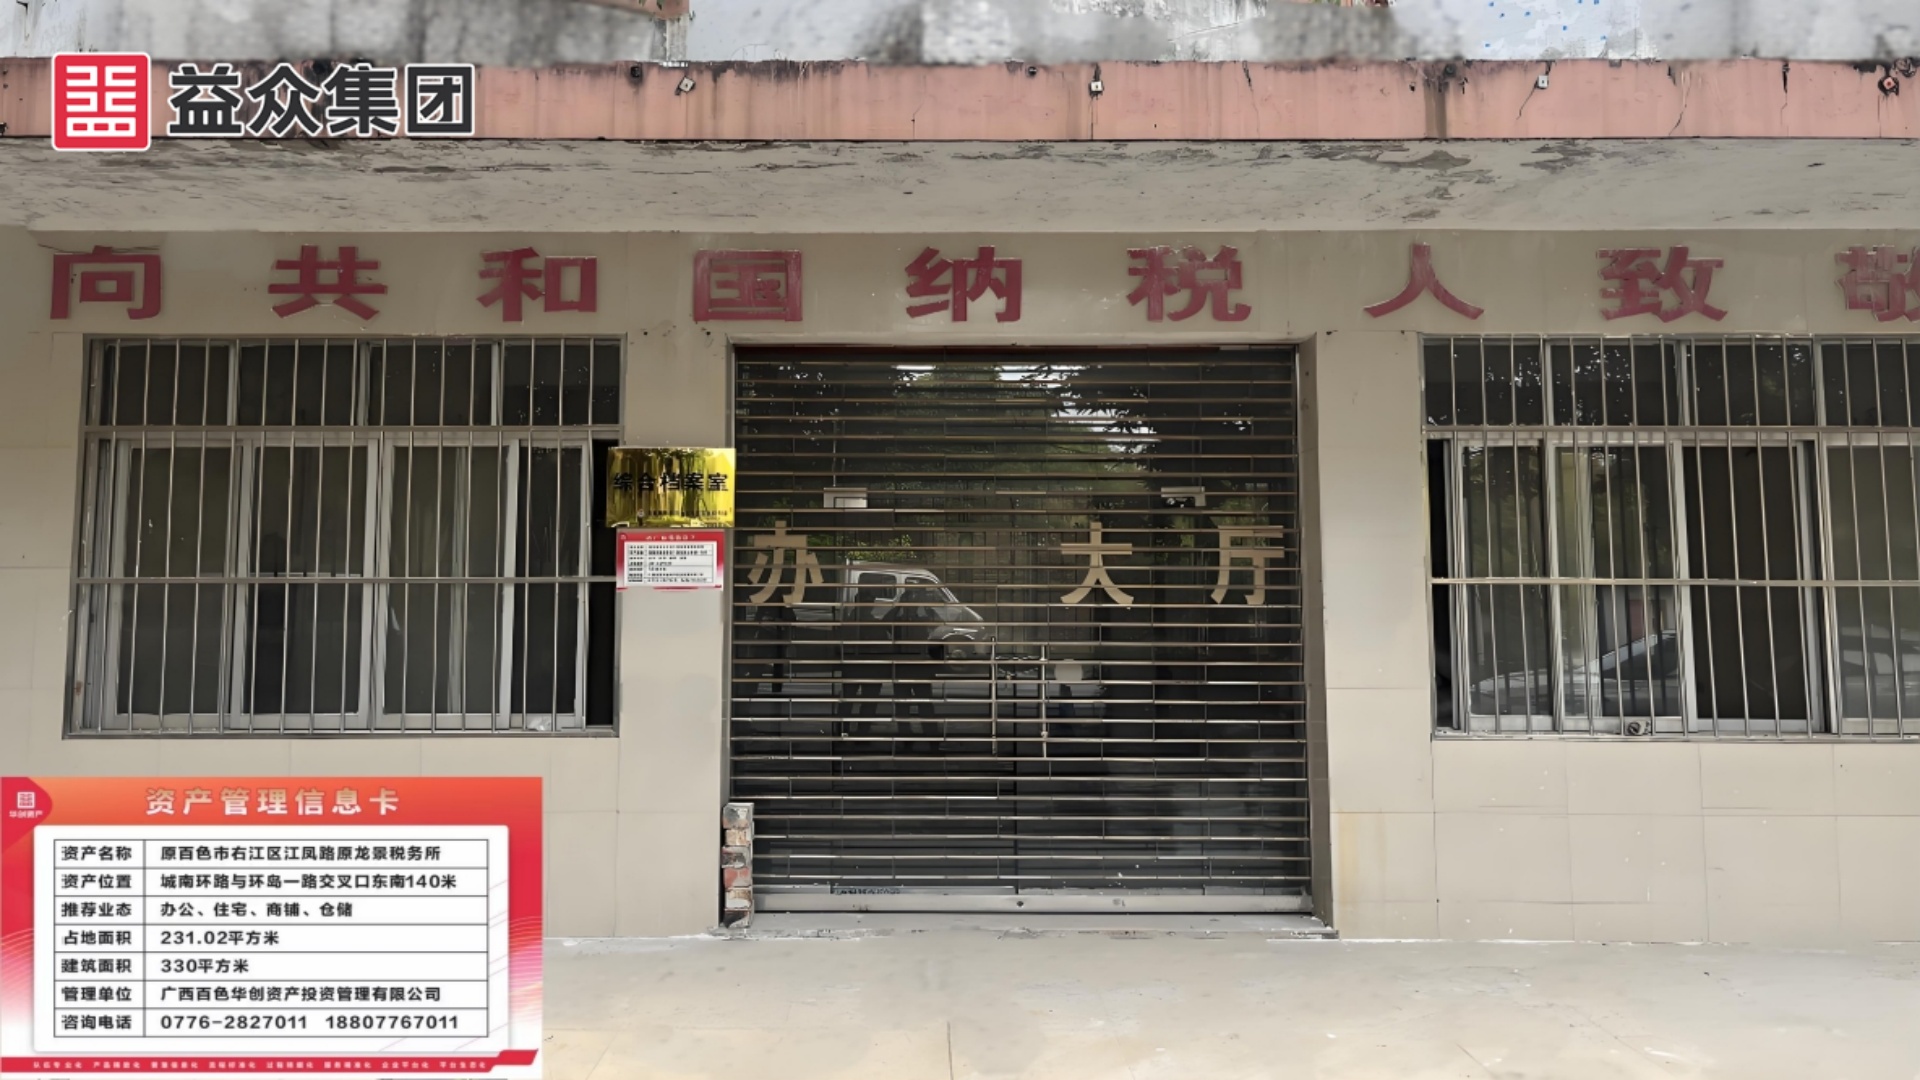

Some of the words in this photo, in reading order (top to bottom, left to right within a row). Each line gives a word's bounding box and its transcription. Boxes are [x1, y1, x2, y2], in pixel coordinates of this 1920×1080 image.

[612, 472, 729, 492] 综合档案室
